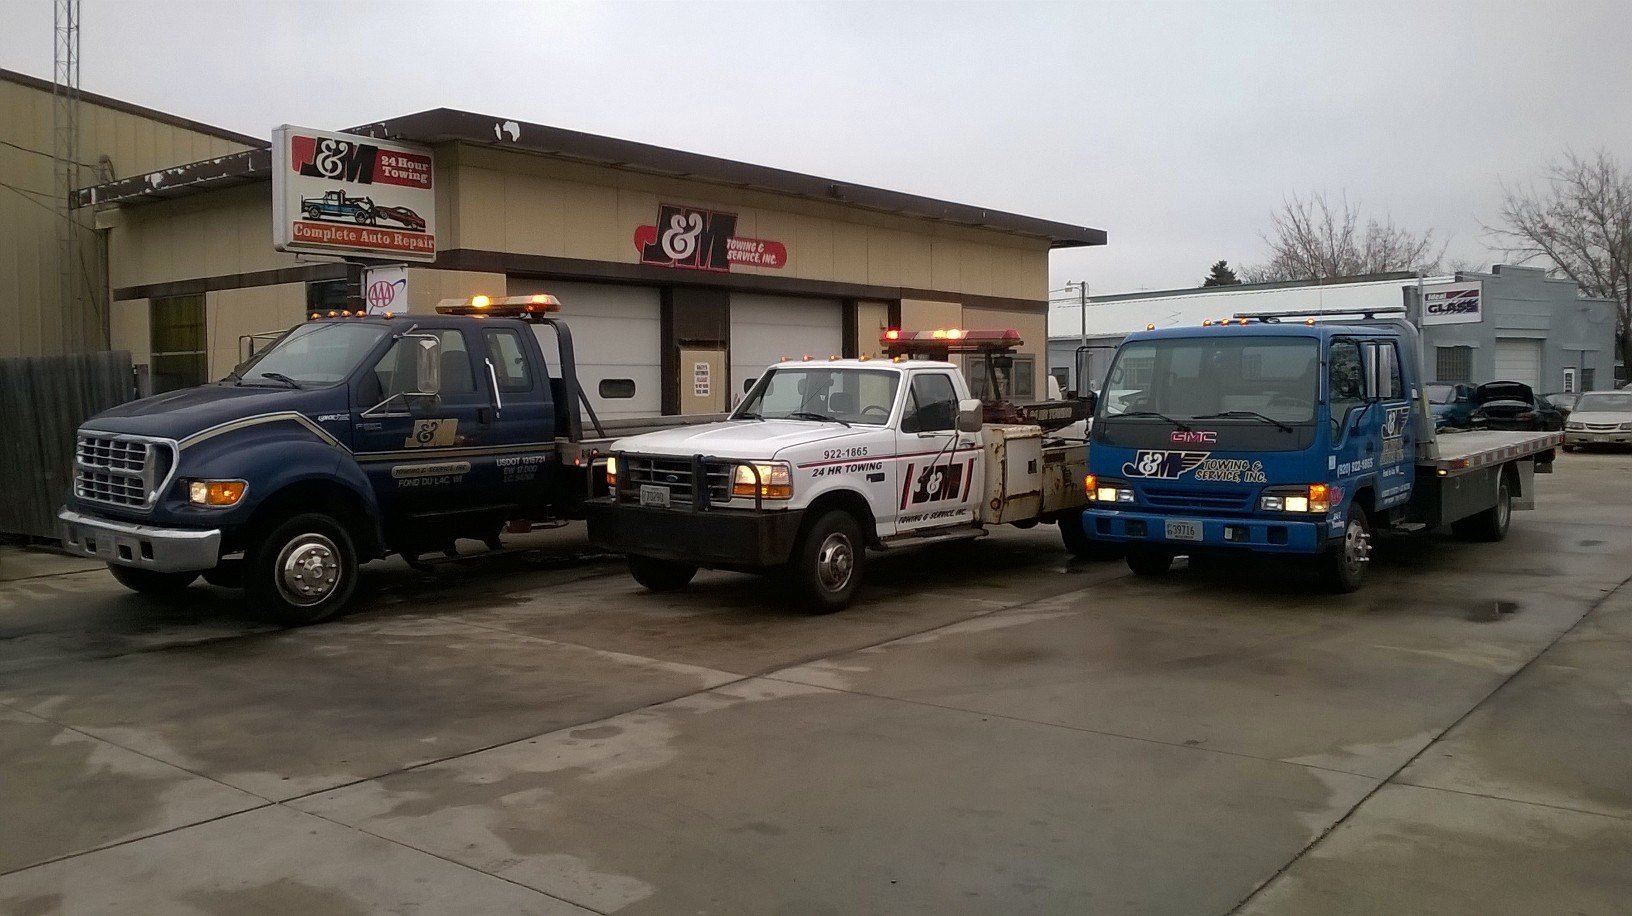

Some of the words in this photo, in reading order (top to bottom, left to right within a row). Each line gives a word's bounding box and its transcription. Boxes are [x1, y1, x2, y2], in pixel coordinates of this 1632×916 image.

[381, 155, 397, 167] 24
[397, 157, 429, 171] Hour
[382, 166, 429, 184] Towing
[293, 223, 357, 243] Complete
[360, 231, 390, 245] Auto
[394, 235, 434, 250] Repair
[642, 204, 737, 271] J&M
[726, 238, 757, 252] TOWING
[757, 242, 765, 253] &
[762, 254, 777, 265] INC.
[370, 282, 394, 305] AAA
[1427, 299, 1479, 314] GLASS
[1171, 431, 1218, 443] GMC
[823, 446, 868, 460] 922-1865
[496, 456, 521, 466] USDOT
[1202, 458, 1249, 471] TOWING
[1249, 460, 1262, 471] &
[812, 468, 826, 478] 24
[827, 465, 842, 476] HR
[845, 462, 883, 474] TOWING
[1244, 472, 1267, 483] INC.
[1172, 524, 1195, 536] 39716
